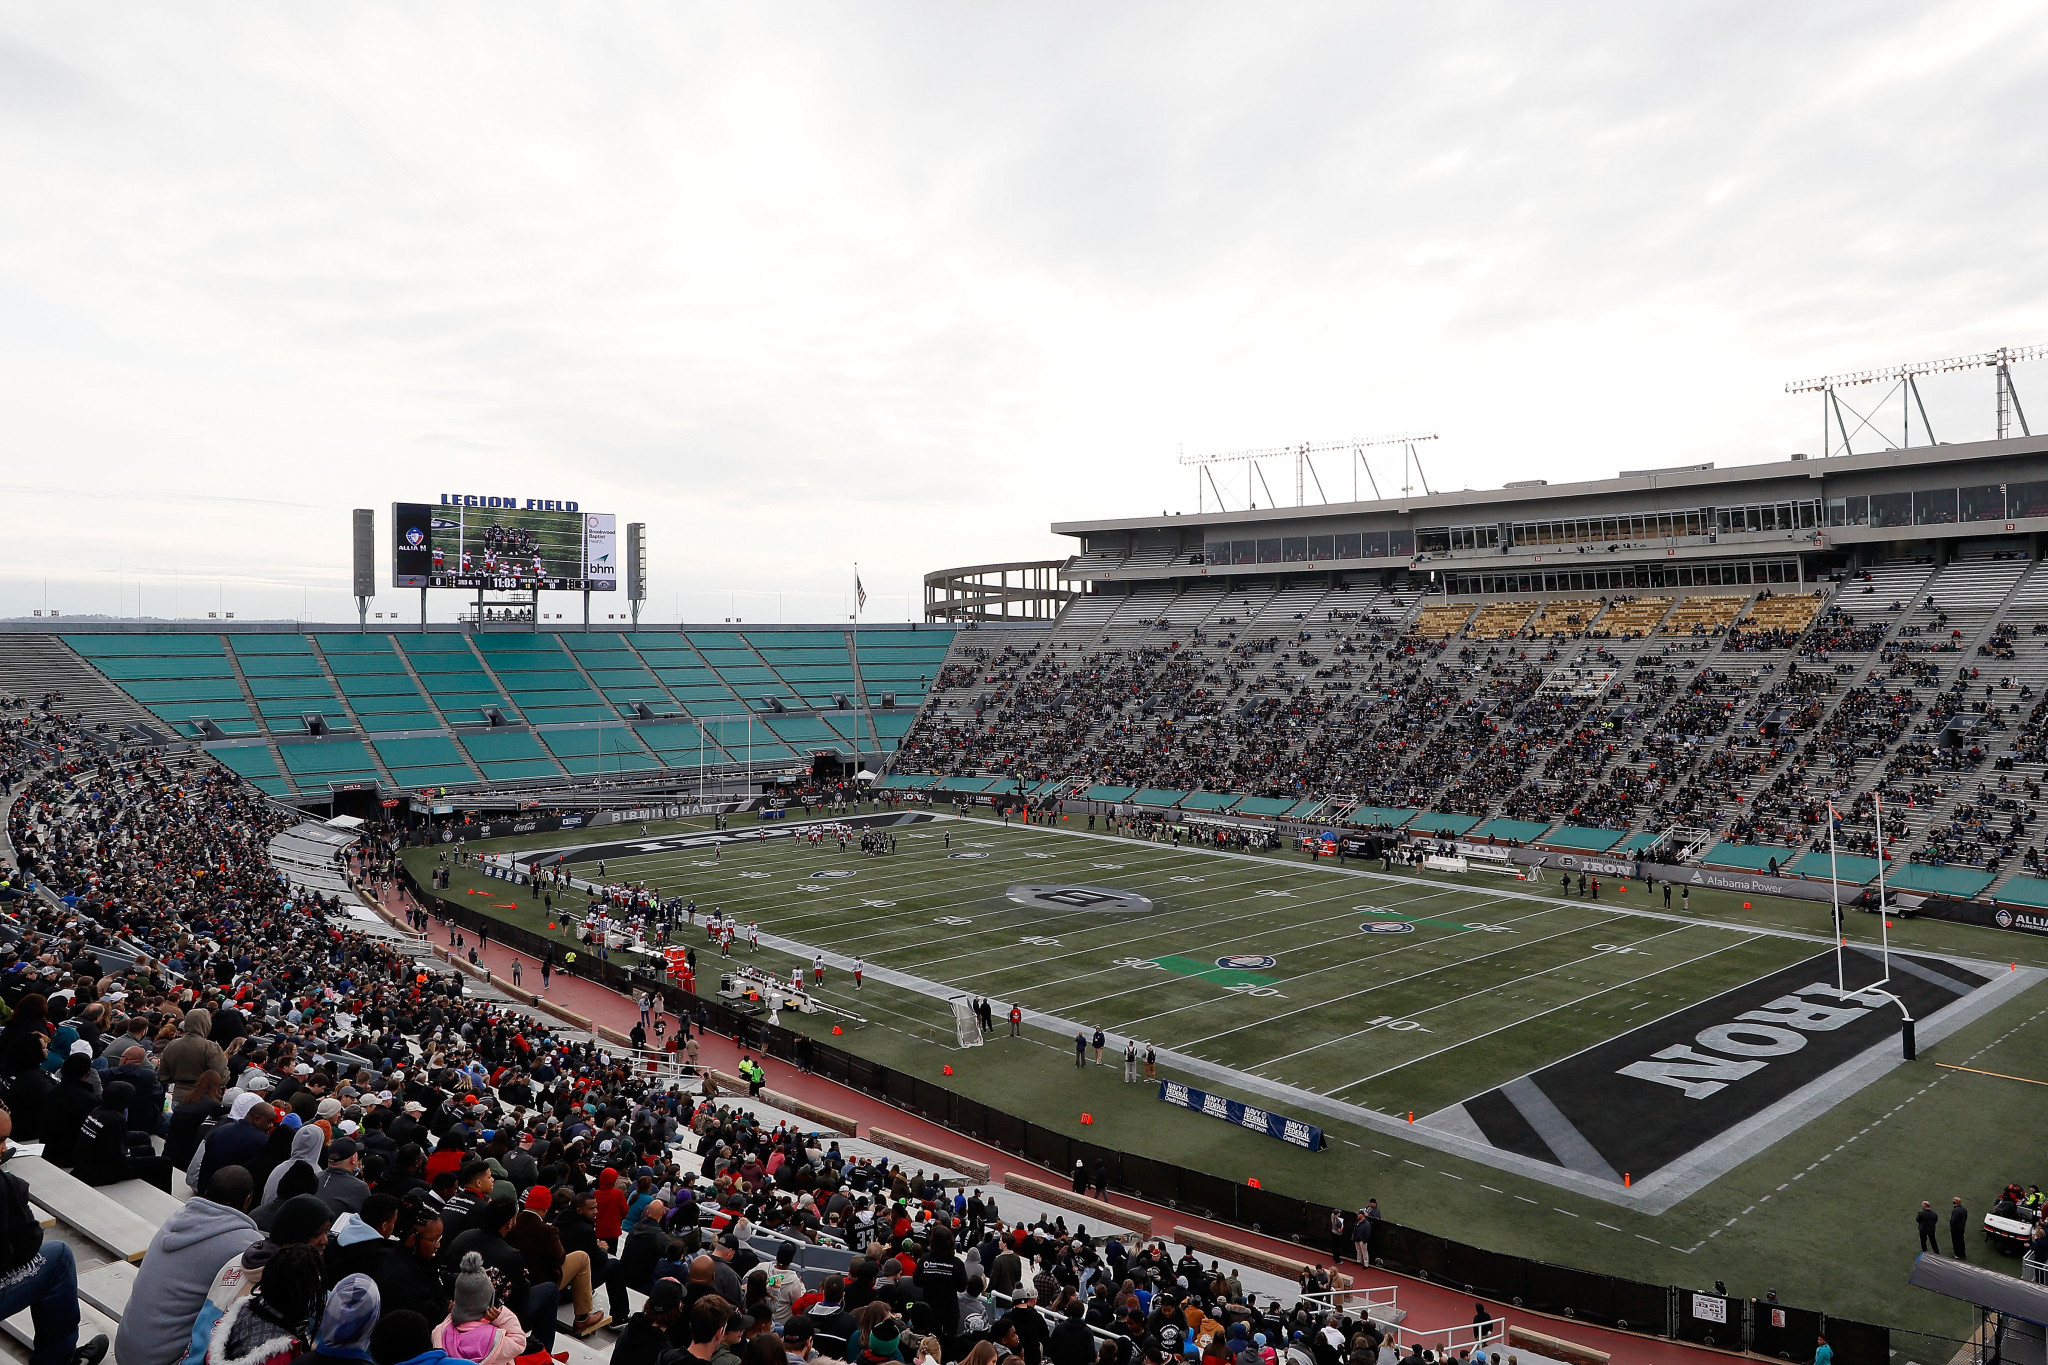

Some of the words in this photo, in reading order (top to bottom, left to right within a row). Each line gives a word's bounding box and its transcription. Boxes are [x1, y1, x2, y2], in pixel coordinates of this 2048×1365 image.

[441, 493, 517, 509] LEGION
[527, 498, 579, 513] FIELD
[2006, 523, 2014, 531] 13
[590, 563, 615, 575] bhm
[435, 577, 441, 586] 0
[493, 577, 517, 588] 11:03
[513, 822, 537, 832] Coca-Cola
[1587, 857, 1626, 866] BIRMINGHAM
[1582, 861, 1631, 876] IRON
[1707, 876, 1750, 890] Alabama
[1752, 880, 1783, 894] Power
[1113, 956, 1160, 970] 30
[1222, 982, 1280, 997] 20
[1366, 1015, 1421, 1031] 10
[1615, 982, 1900, 1100] IRON
[1167, 1082, 1183, 1092] NAVY
[1166, 1088, 1189, 1099] FEDERAL
[1205, 1094, 1221, 1104] NAVY
[1164, 1095, 1176, 1104] Credit
[1176, 1099, 1188, 1107] Union
[1203, 1099, 1227, 1111] FEDERAL
[1202, 1107, 1214, 1116] Credit
[1214, 1110, 1227, 1119] Union
[1245, 1106, 1261, 1117] NAVY
[1243, 1112, 1268, 1126] FEDERAL
[1242, 1120, 1254, 1130] Credit
[1254, 1124, 1267, 1133] Union
[1286, 1120, 1303, 1131] NAVY
[1284, 1126, 1310, 1139] FEDERAL
[1283, 1134, 1296, 1143] Credit
[1296, 1138, 1309, 1148] Union
[856, 1228, 875, 1251] 33
